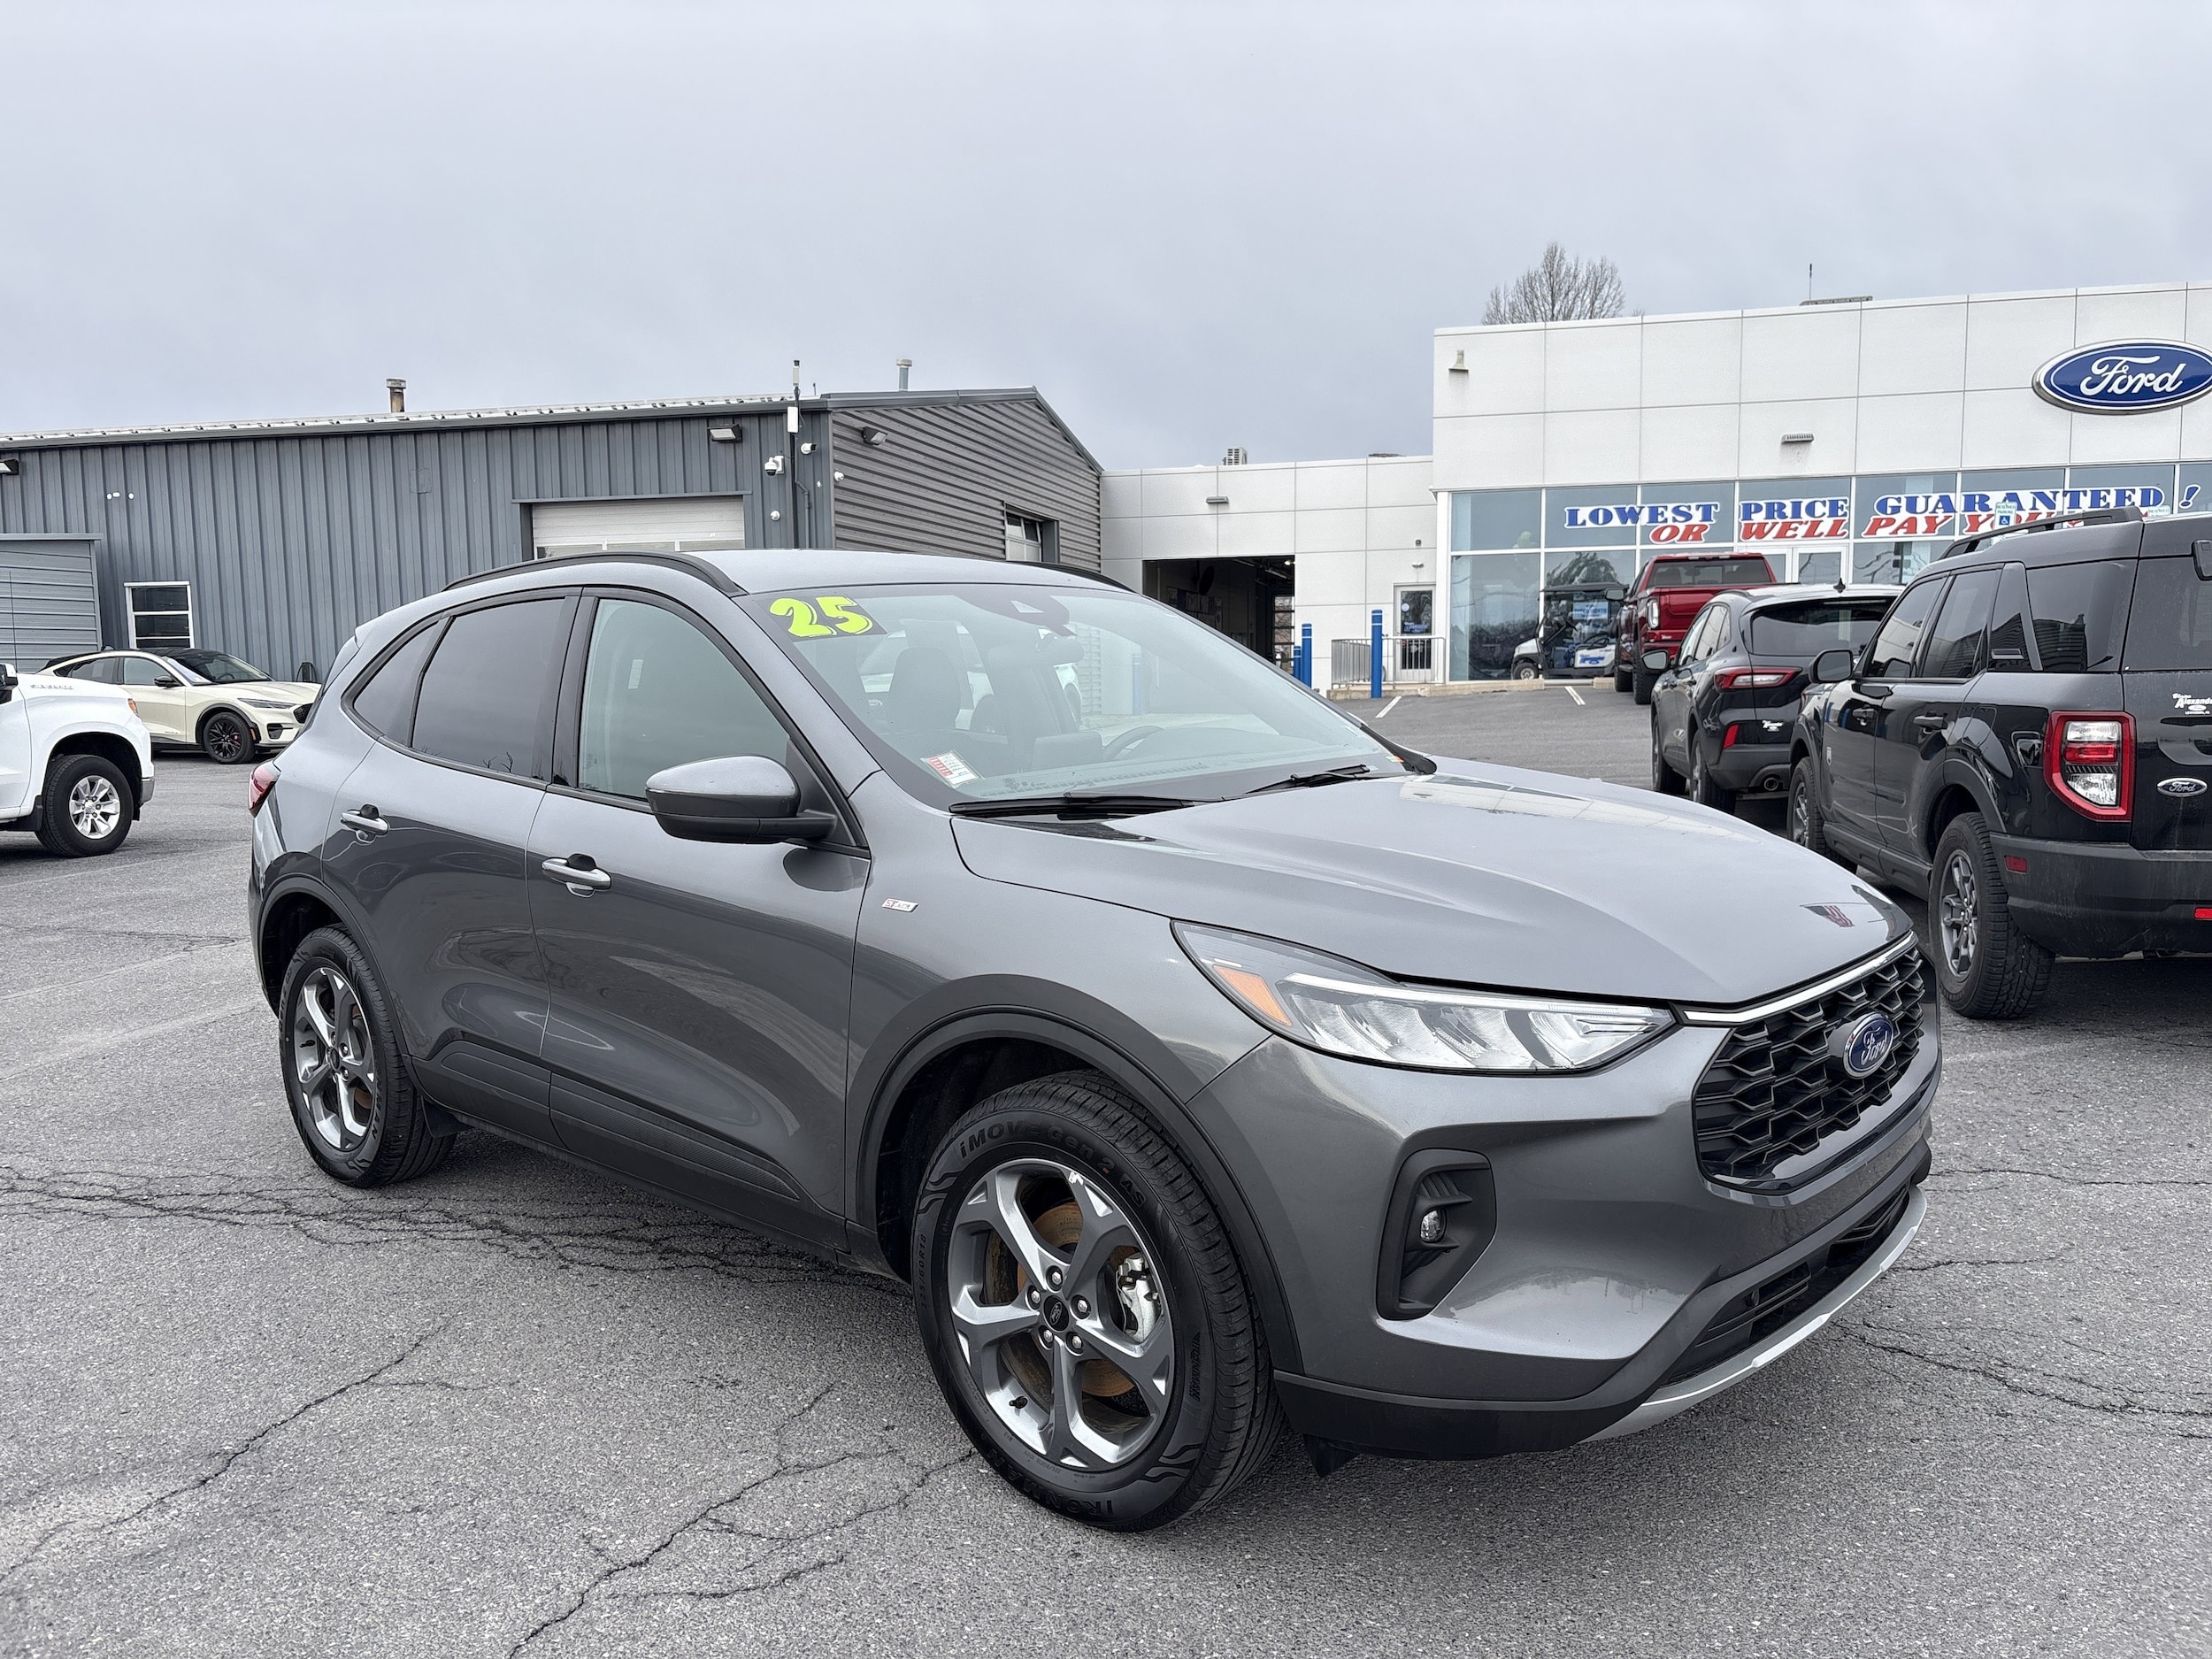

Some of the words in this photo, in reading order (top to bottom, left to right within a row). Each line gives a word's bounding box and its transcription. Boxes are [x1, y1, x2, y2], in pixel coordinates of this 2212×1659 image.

[2080, 355, 2186, 396] Ford
[1565, 503, 1719, 527] LOWEST
[1740, 498, 1848, 521] PRICE
[1875, 487, 2163, 516] GUARANTEED
[1650, 523, 1709, 542] OR
[1740, 518, 1848, 541] WE'LL
[1862, 514, 1952, 538] PAY
[768, 595, 874, 638] 25
[2169, 781, 2196, 793] Ford
[1861, 1026, 1888, 1066] Ford
[1047, 1125, 1095, 1160] Gen
[1119, 1173, 1147, 1208] AS
